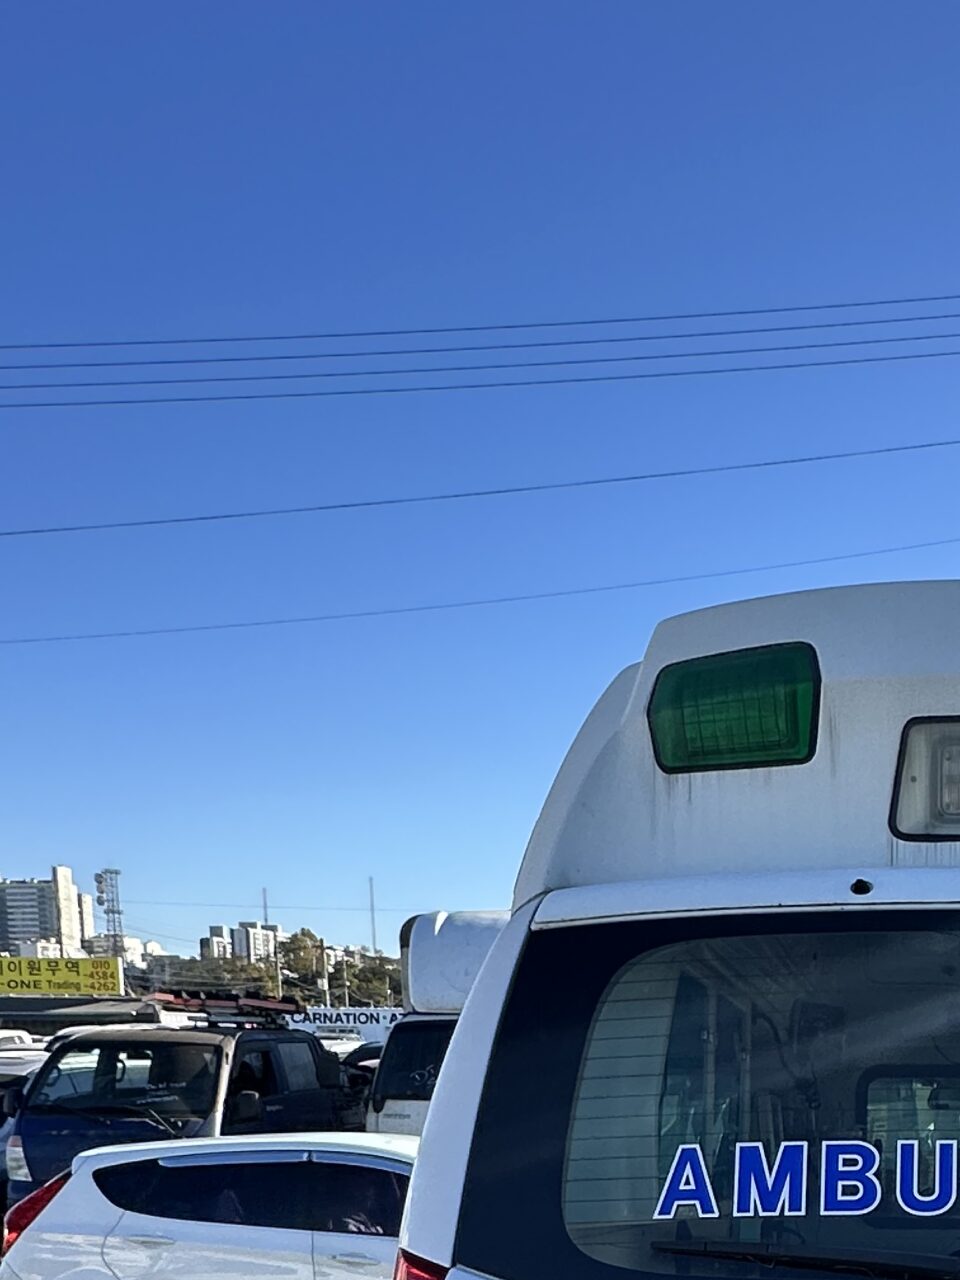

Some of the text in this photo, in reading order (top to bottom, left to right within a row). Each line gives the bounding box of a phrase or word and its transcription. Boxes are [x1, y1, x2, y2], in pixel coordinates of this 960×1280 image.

[0, 960, 81, 977] 이원무역
[91, 960, 111, 970] 010
[46, 980, 81, 992] Trading
[290, 1012, 380, 1025] CARNATION
